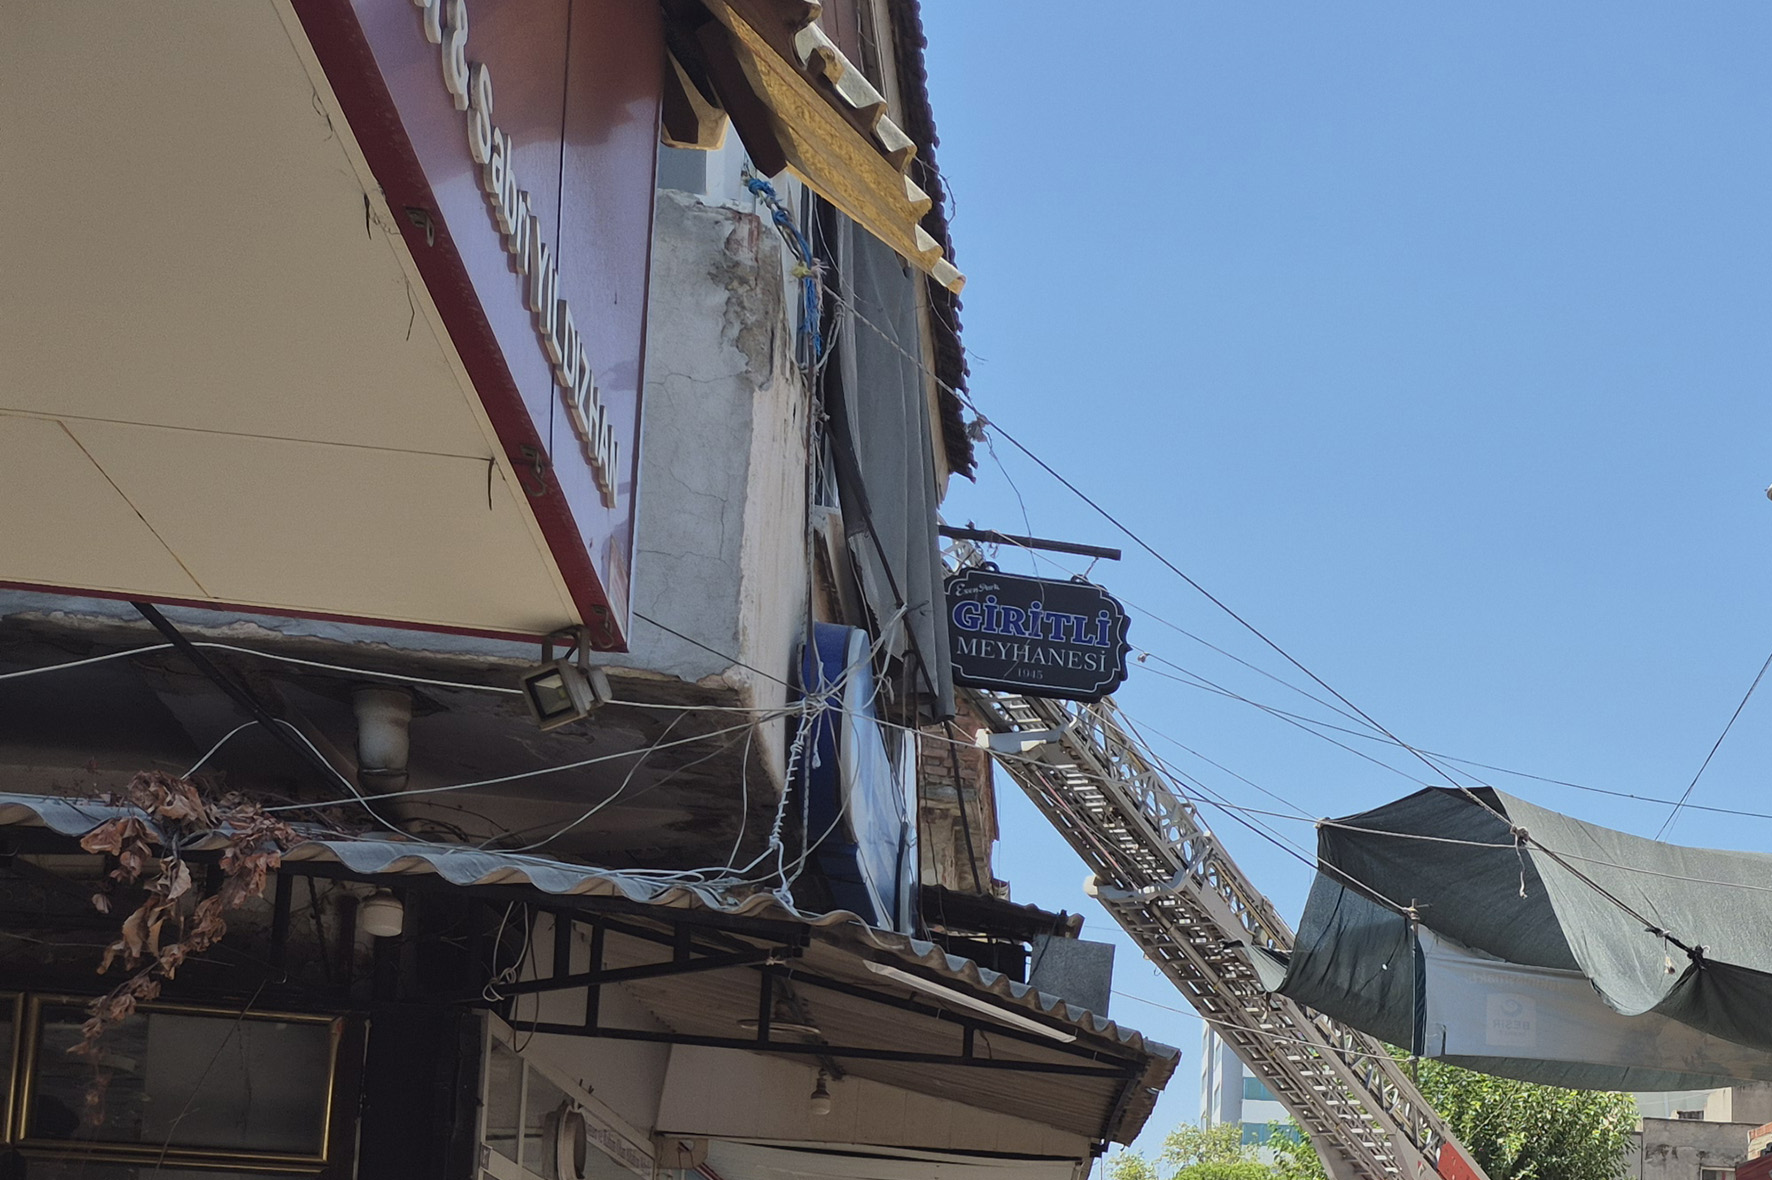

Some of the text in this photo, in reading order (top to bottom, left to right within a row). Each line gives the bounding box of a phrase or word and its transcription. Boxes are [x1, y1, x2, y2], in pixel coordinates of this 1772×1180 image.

[467, 61, 531, 276] Sabri
[528, 215, 618, 509] YILDIZHAN
[952, 594, 1113, 648] GİRİTLİ
[956, 636, 1108, 673] MEYHANESİ
[1017, 667, 1043, 680] 1945
